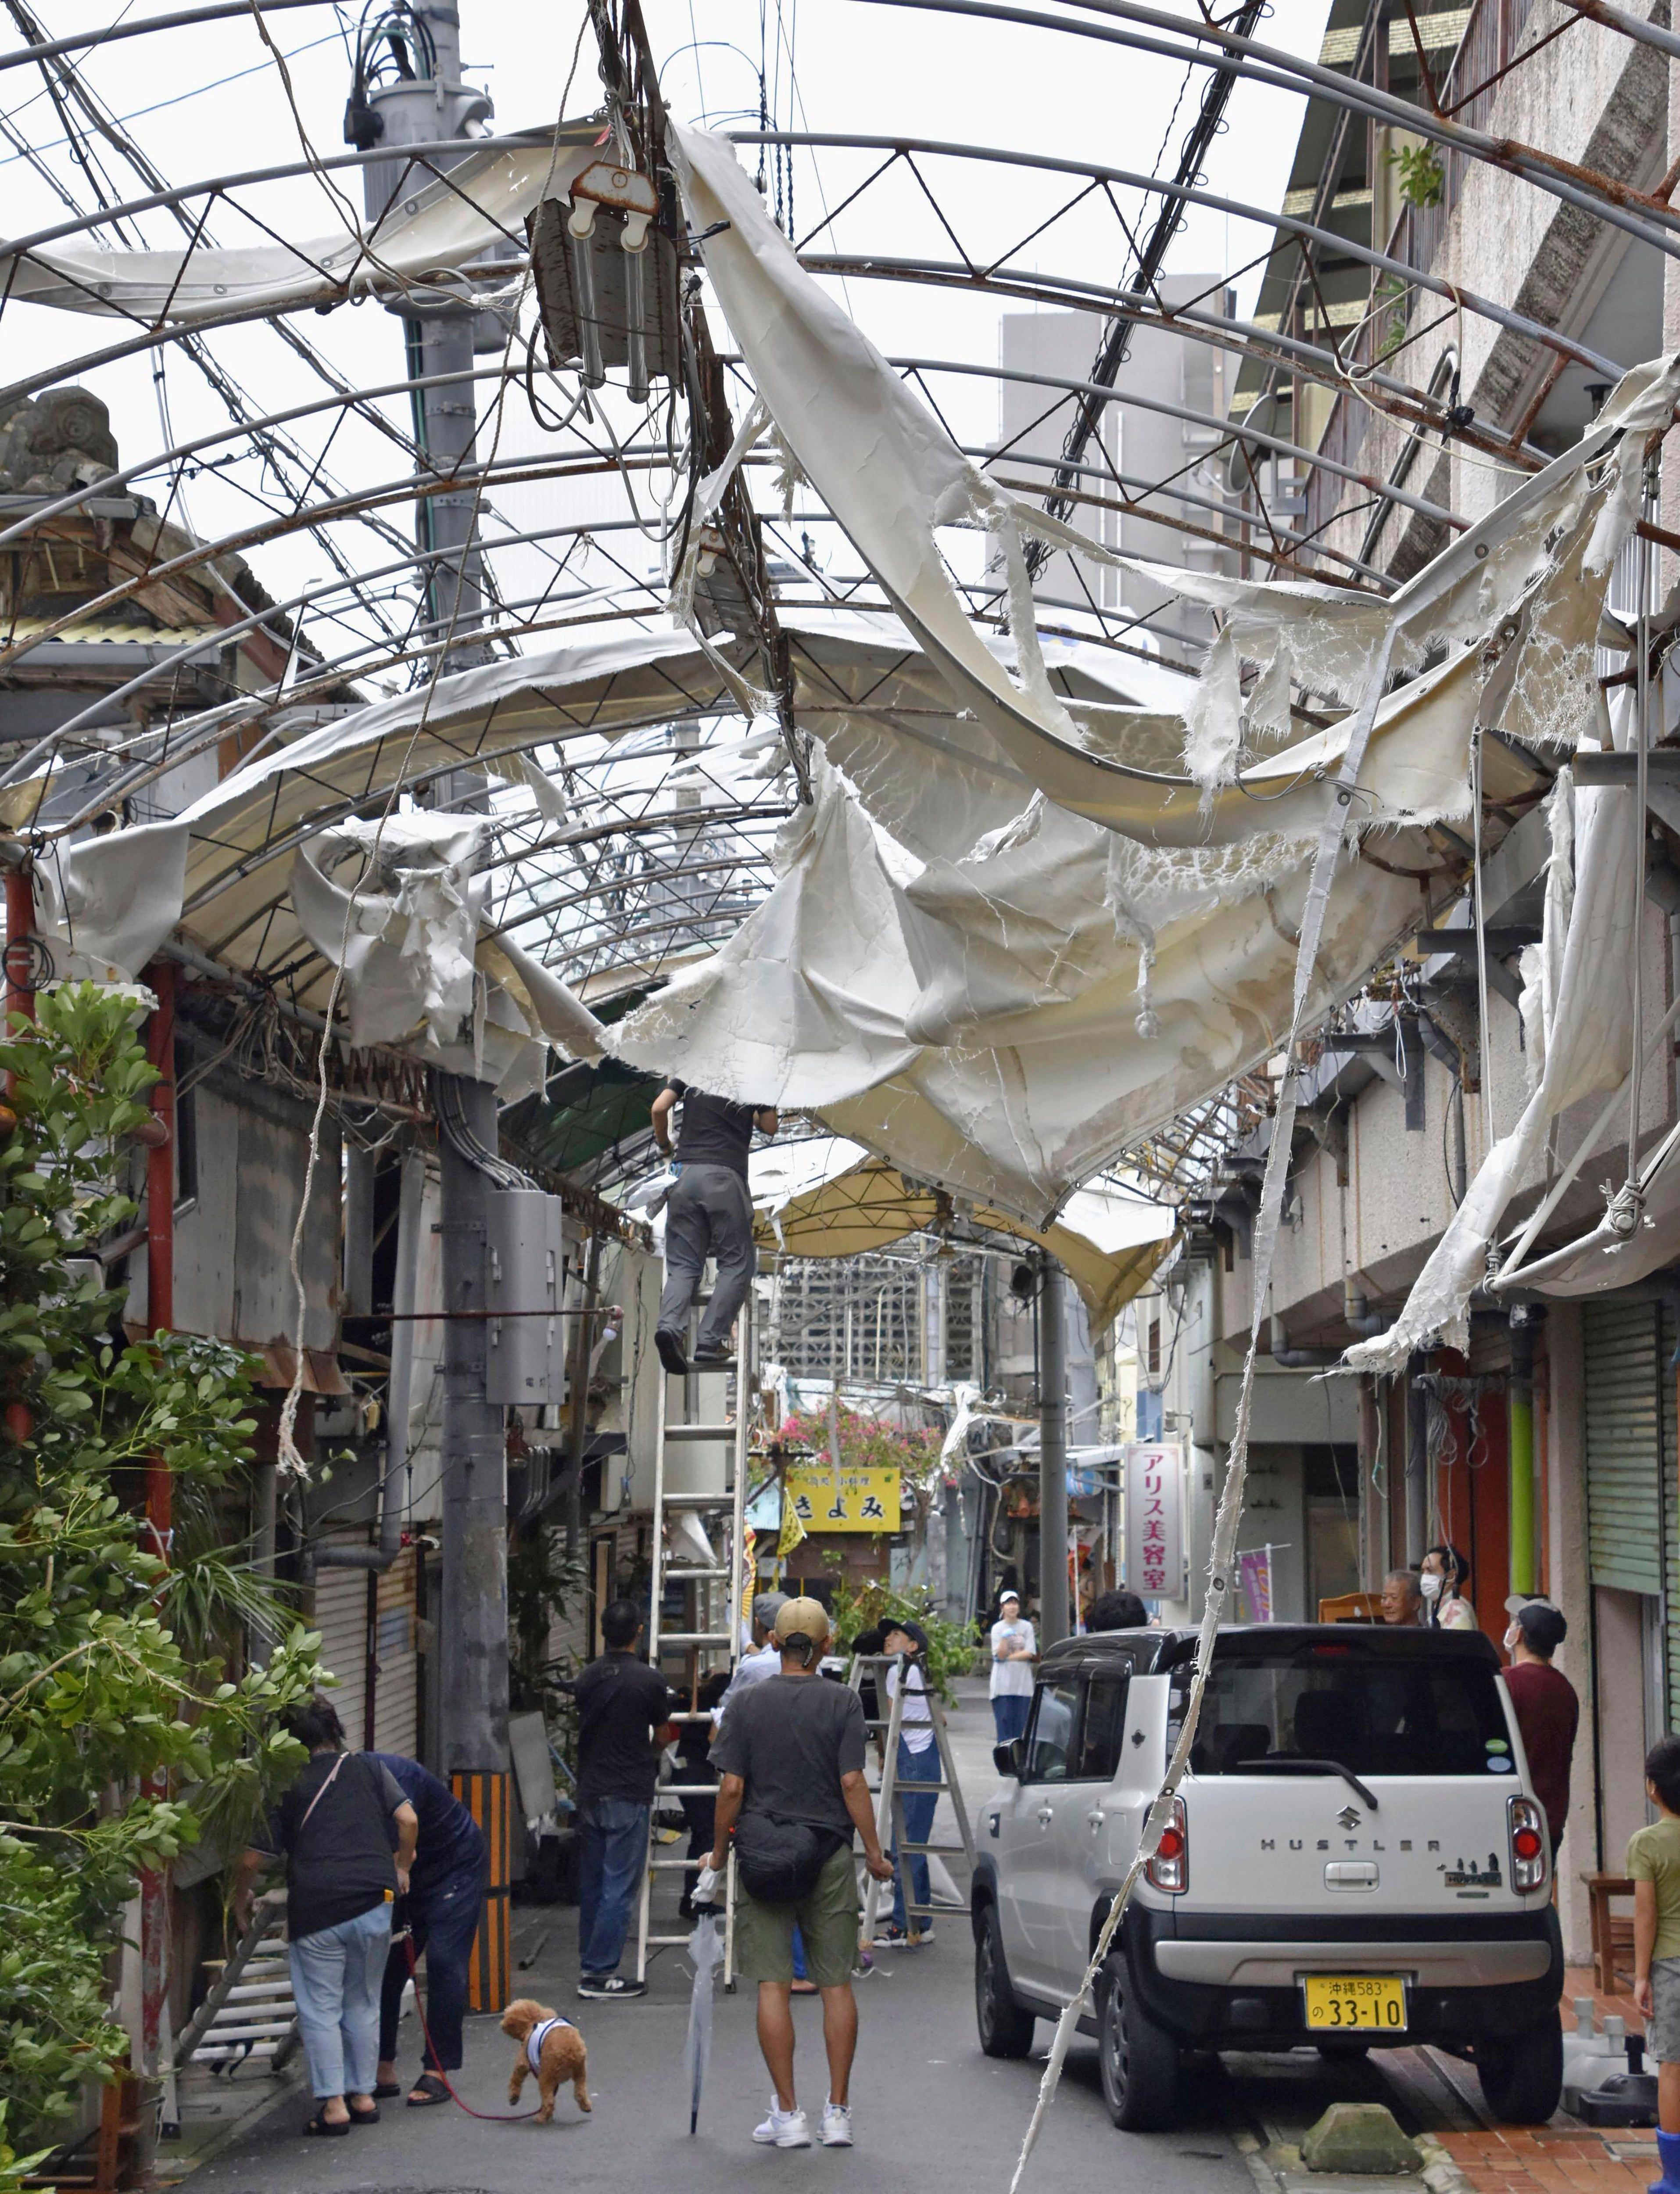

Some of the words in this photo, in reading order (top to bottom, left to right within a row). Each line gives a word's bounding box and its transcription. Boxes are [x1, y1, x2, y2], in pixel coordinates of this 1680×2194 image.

[795, 1495, 884, 1519] きよみ
[1143, 1454, 1165, 1590] アリス美容室
[1261, 1839, 1440, 1851] HUSTLER
[1313, 2006, 1323, 2018] の
[1329, 2000, 1400, 2026] 33-10
